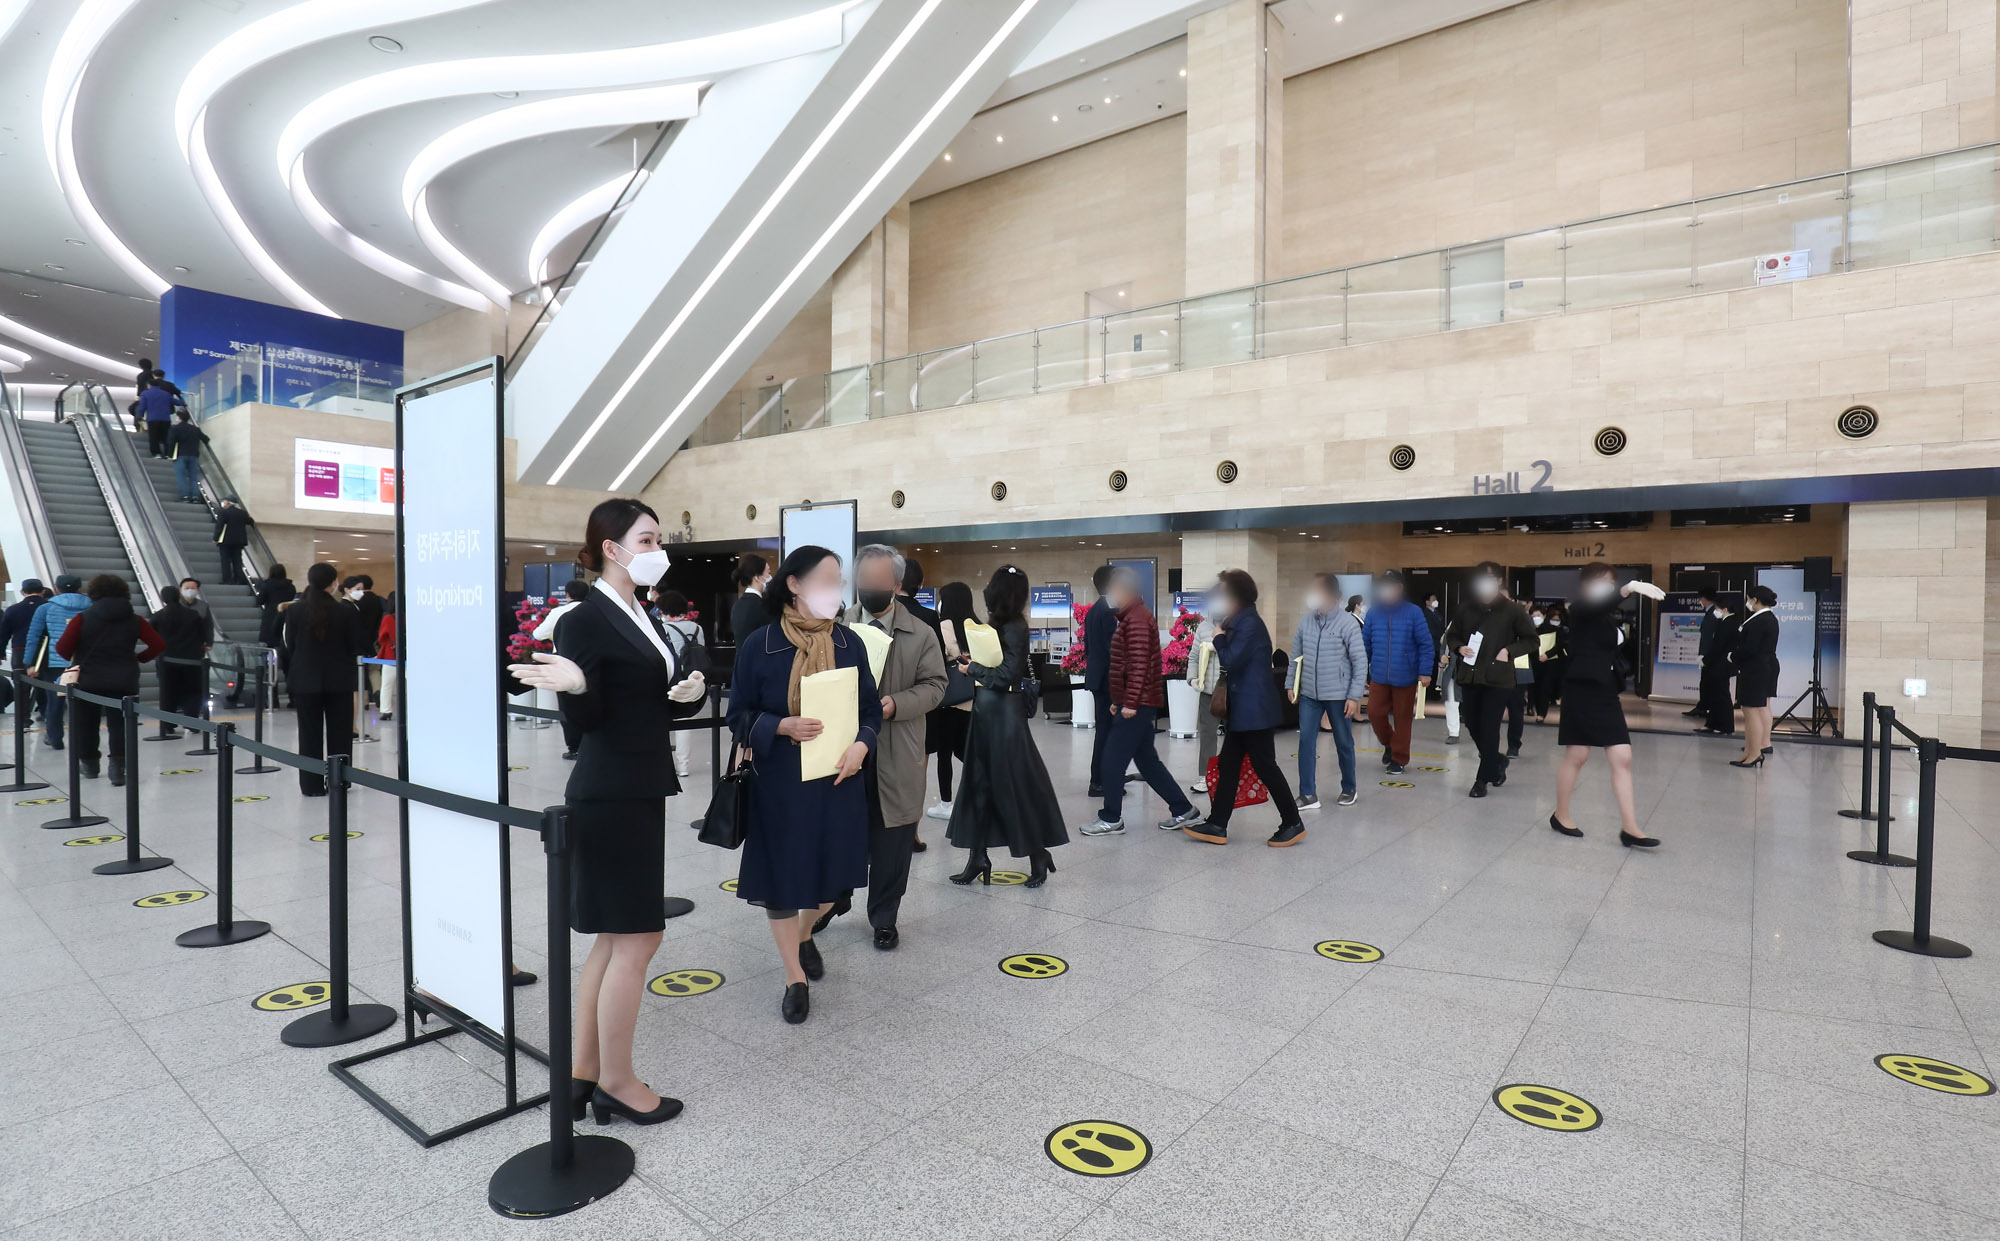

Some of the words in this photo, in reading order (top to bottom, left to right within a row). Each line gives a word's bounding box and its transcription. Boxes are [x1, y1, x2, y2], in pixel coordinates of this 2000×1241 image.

[1473, 471, 1521, 496] Hall
[1530, 459, 1554, 493] 2
[668, 531, 683, 545] Hall
[685, 525, 693, 543] 3
[1564, 547, 1591, 558] Hall
[1594, 542, 1606, 557] 2
[1034, 592, 1040, 602] 7
